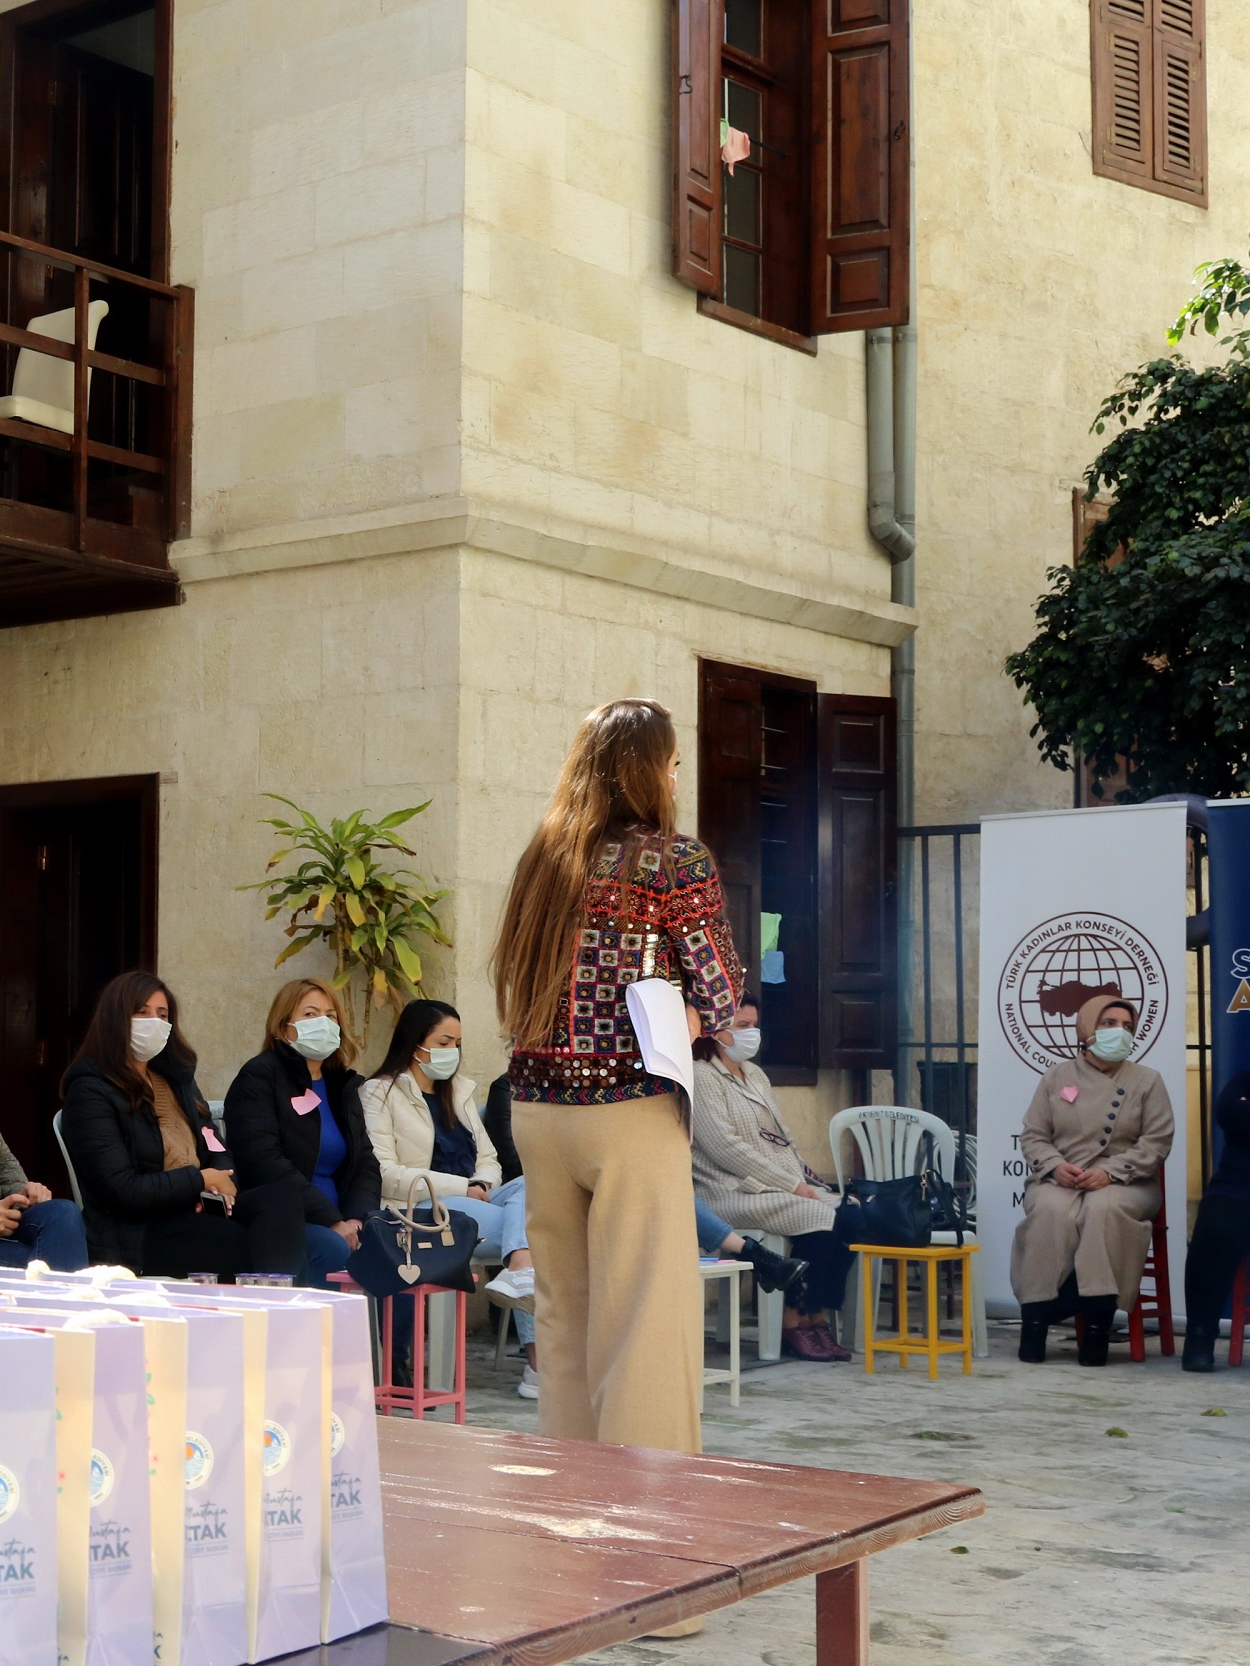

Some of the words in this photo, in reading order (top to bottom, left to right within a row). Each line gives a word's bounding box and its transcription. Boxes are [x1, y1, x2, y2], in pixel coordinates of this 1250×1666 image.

[1006, 960, 1023, 990] TÜRK
[1022, 921, 1072, 960] KADINLAR
[1075, 920, 1127, 941] KONSEYİ
[1124, 937, 1160, 986] DERNEĞİ
[1005, 1002, 1032, 1054] NATIONAL
[1136, 1000, 1159, 1043] WOMEN
